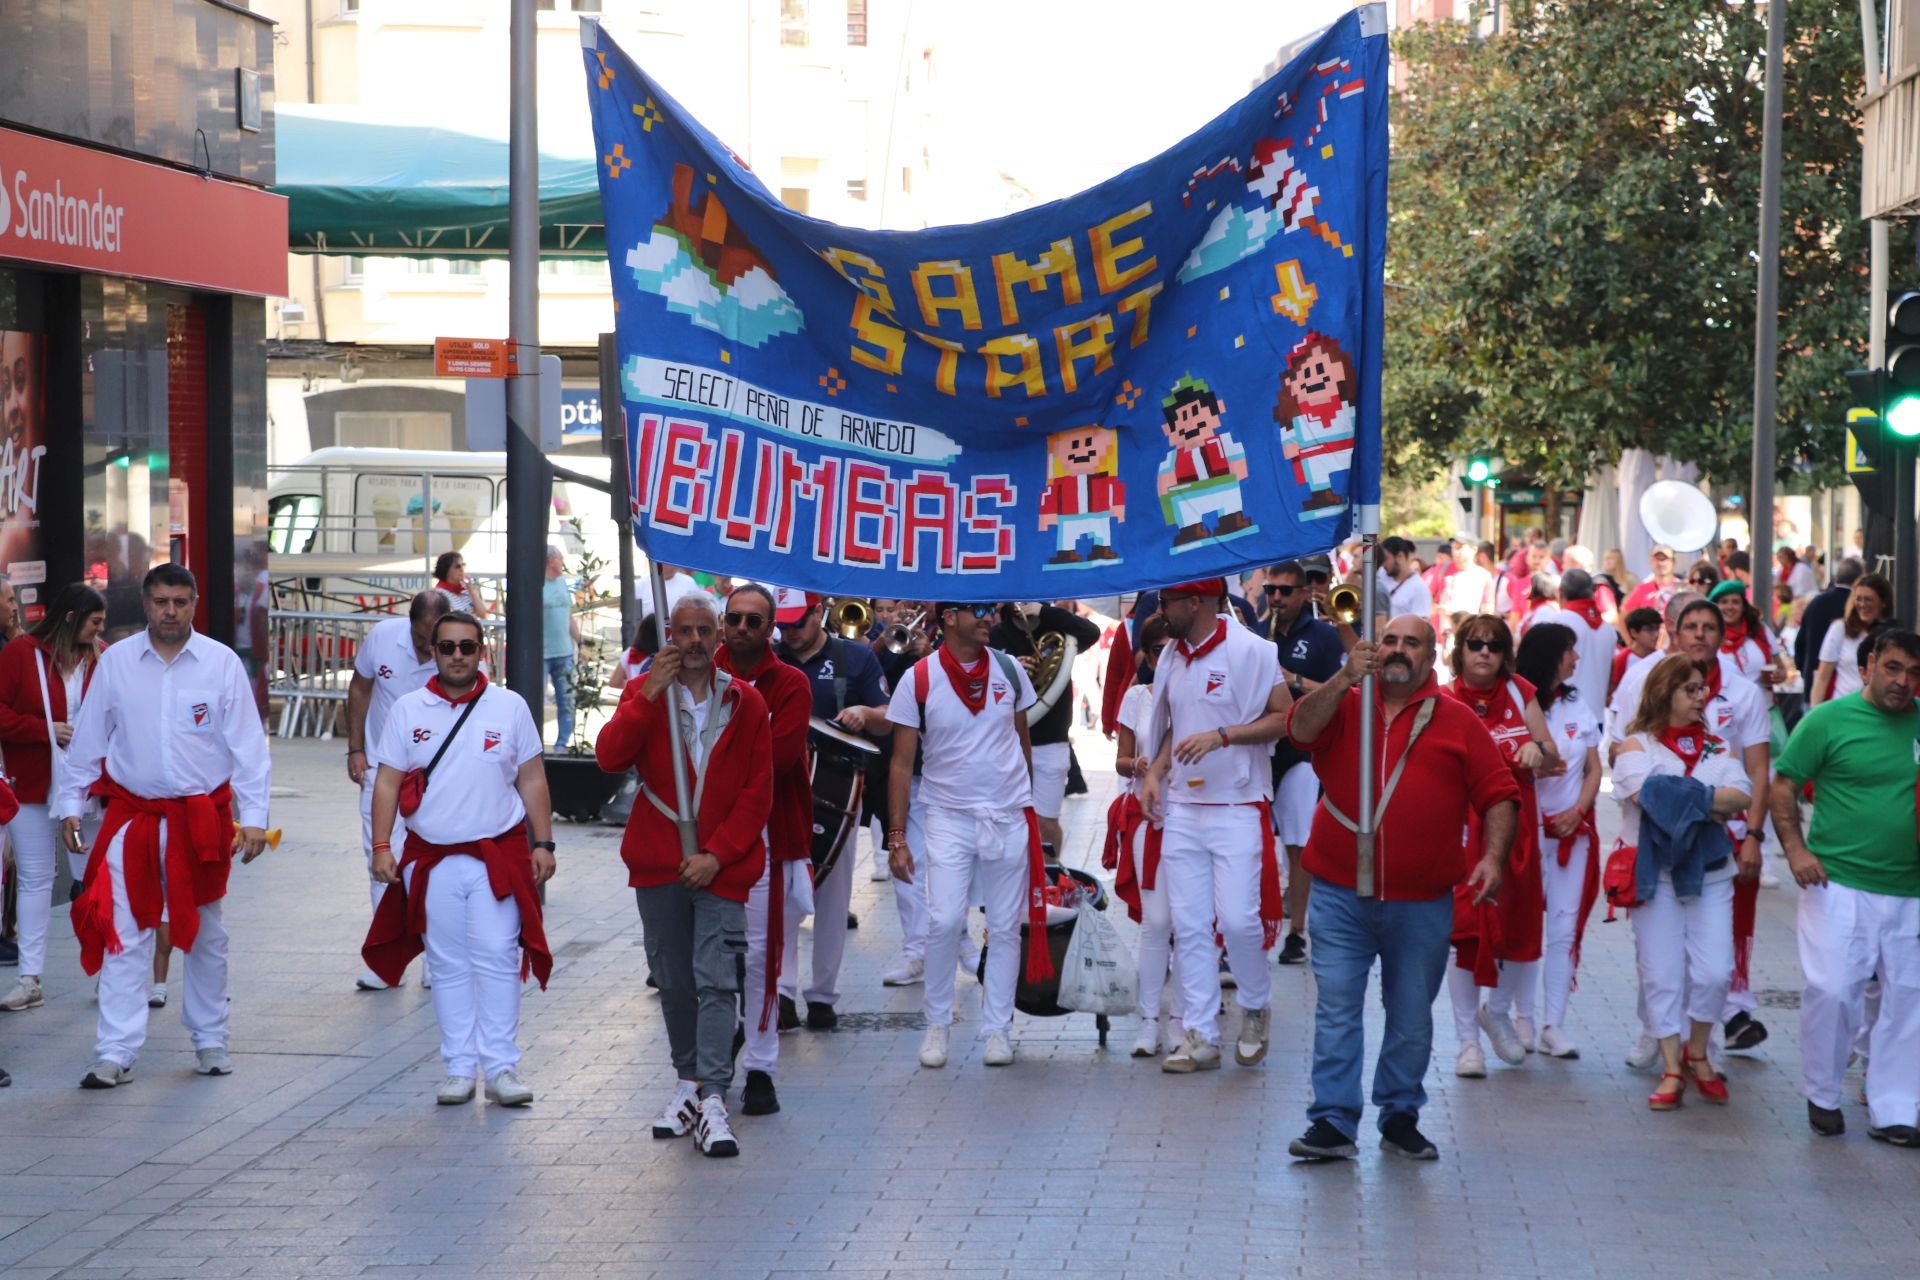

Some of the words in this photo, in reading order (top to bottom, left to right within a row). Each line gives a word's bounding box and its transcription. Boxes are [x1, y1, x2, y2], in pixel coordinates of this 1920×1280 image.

[15, 170, 124, 252] Santander
[806, 200, 1158, 331] GAME
[849, 281, 1164, 398] START
[661, 367, 733, 409] SELECT
[745, 388, 789, 430] PEÑA
[801, 405, 824, 438] DE
[840, 414, 916, 456] ARNEDO
[0, 437, 47, 515] ART
[368, 575, 429, 590] HELADO
